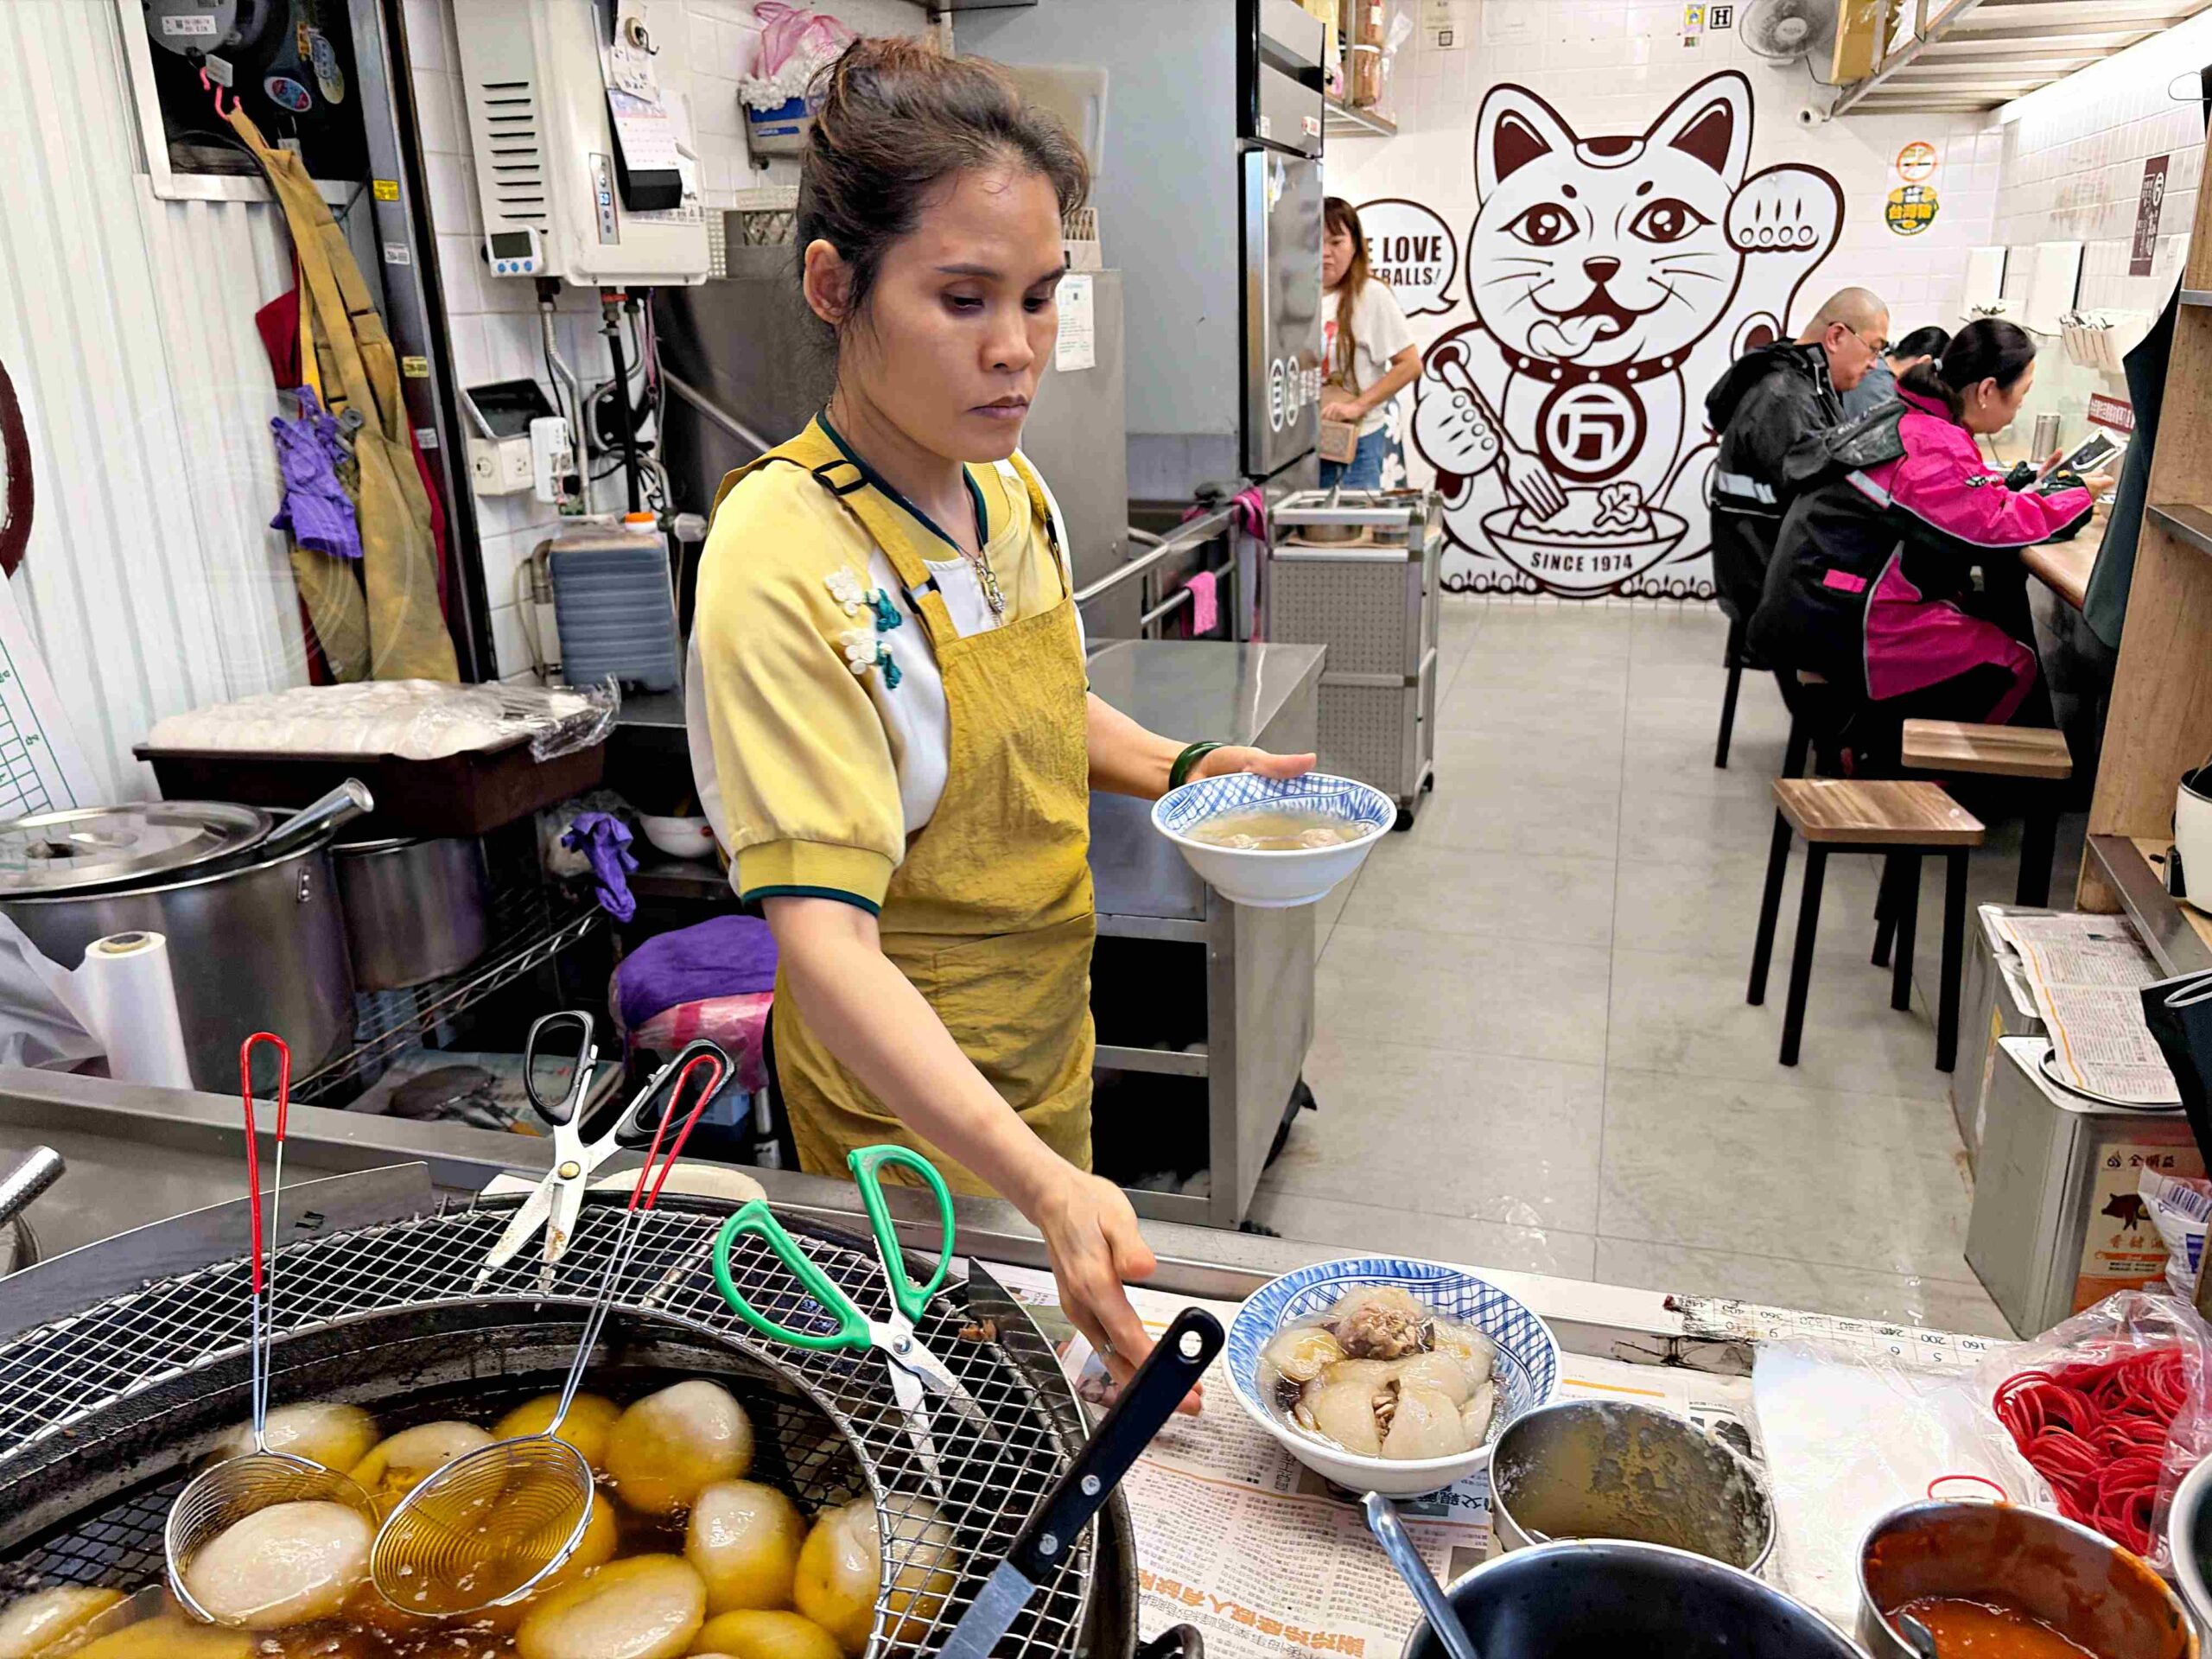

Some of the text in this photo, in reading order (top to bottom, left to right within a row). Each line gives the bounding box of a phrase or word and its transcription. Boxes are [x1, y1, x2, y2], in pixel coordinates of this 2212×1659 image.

[1382, 236, 1442, 263] LOVE
[1370, 267, 1441, 286] TBALLS!
[1531, 551, 1632, 572] SINCE 1974
[1921, 1333, 1947, 1345] 200
[1891, 1346, 1901, 1356] 6
[1962, 1340, 1987, 1351] 160
[1933, 1352, 1942, 1363] 5
